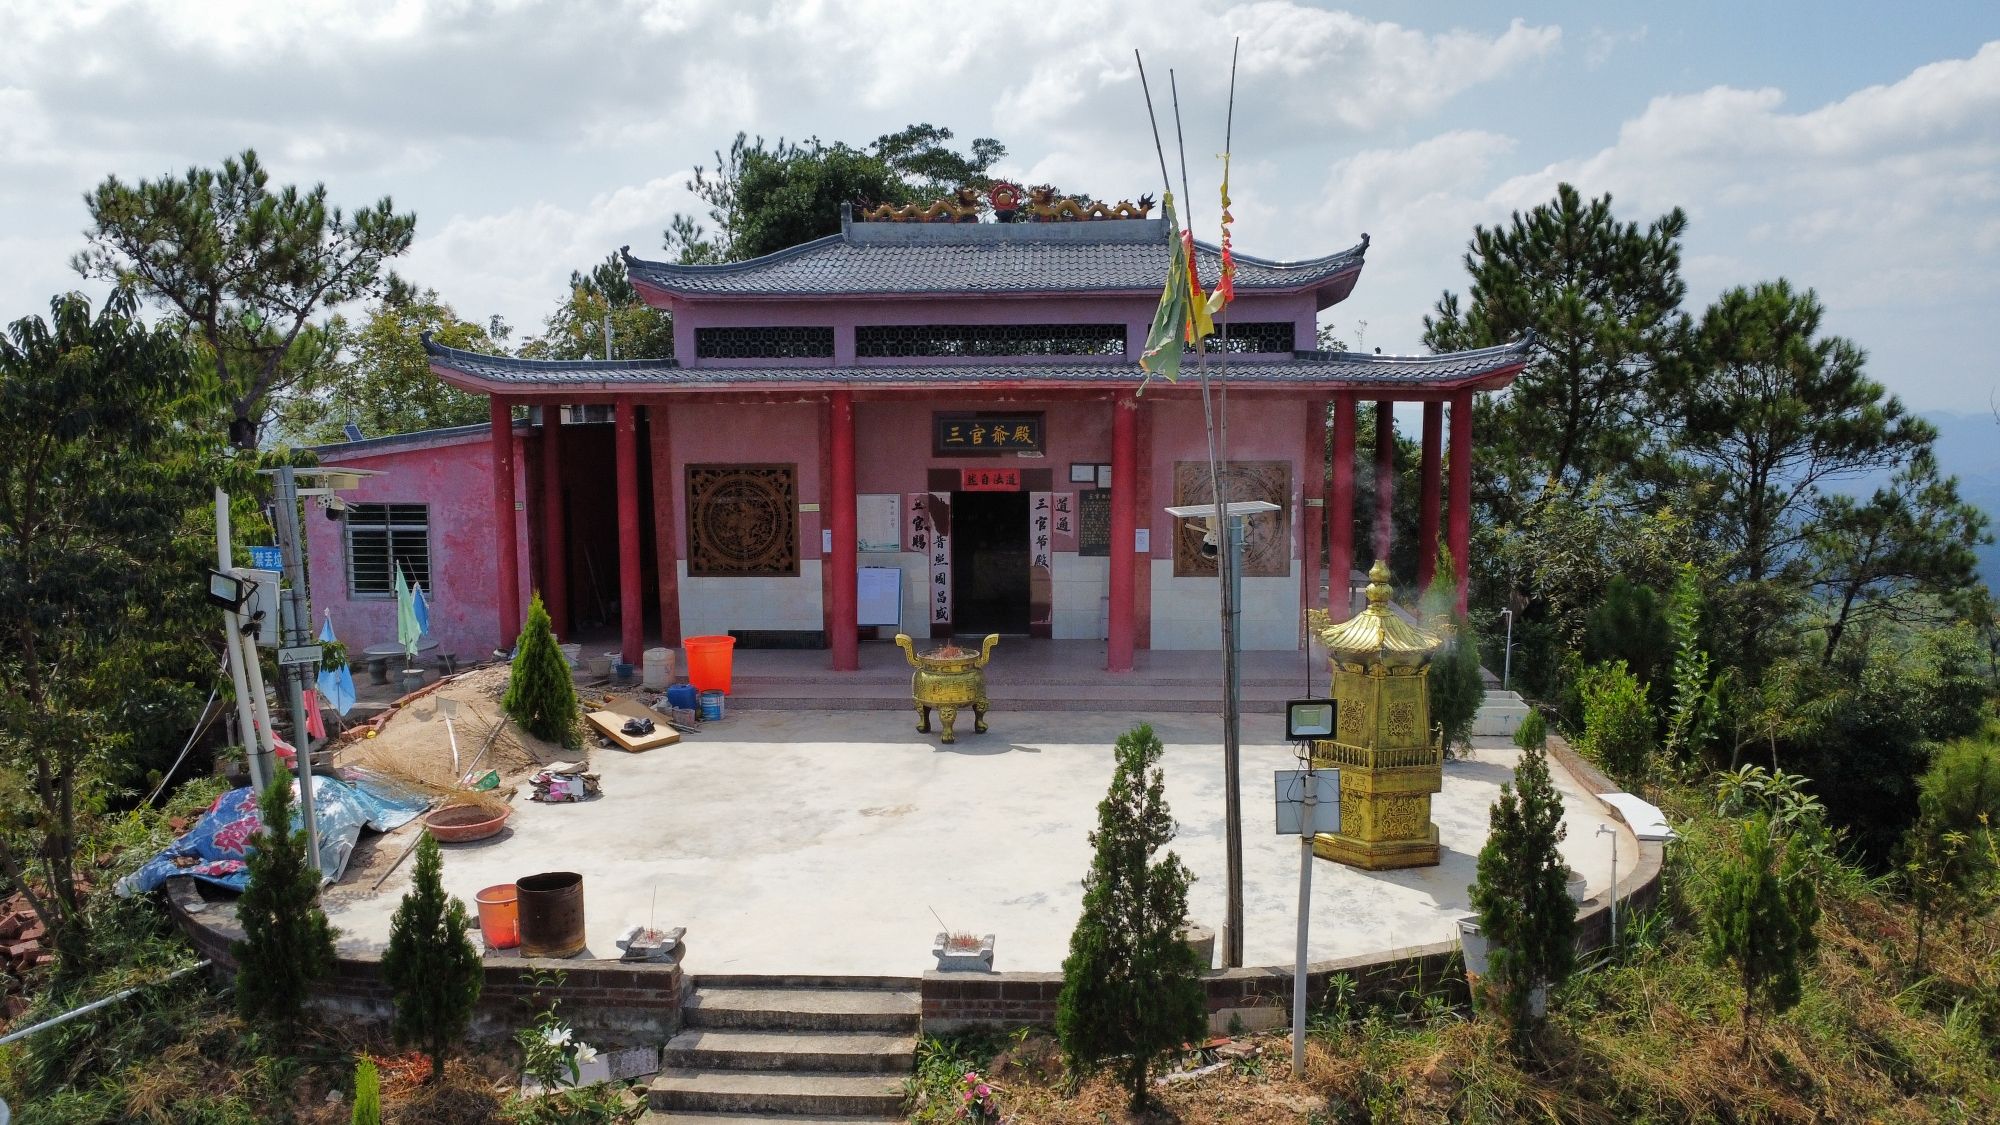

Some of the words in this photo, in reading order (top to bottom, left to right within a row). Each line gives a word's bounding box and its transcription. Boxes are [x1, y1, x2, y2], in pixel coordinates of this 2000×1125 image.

[945, 423, 1034, 446] 三官爺殿
[249, 551, 282, 568] 禁丢垃
